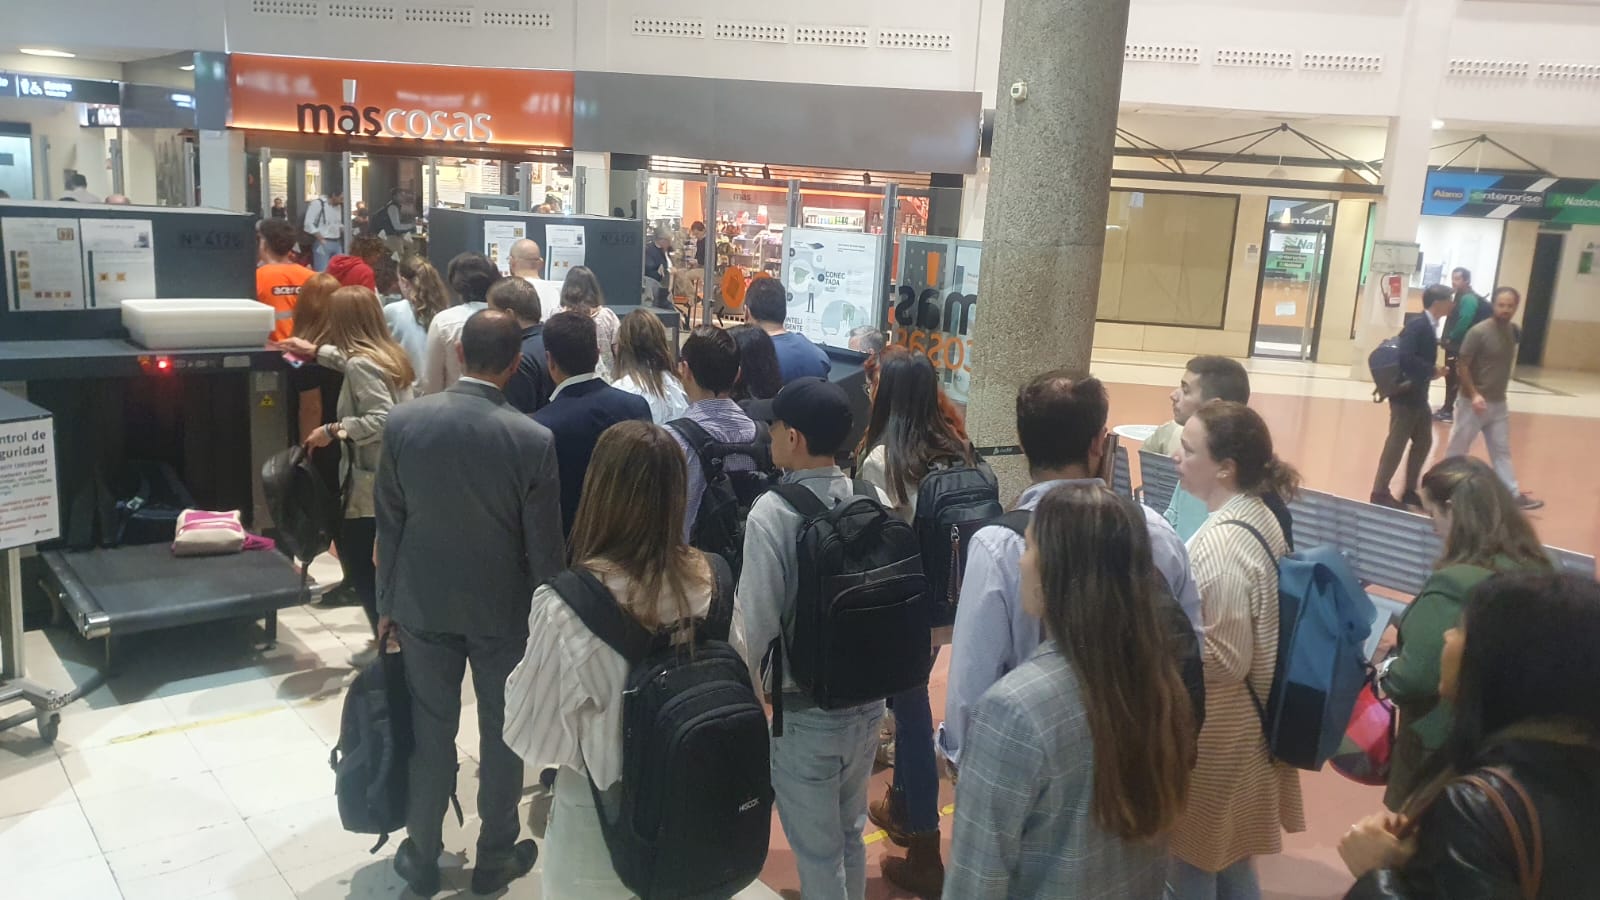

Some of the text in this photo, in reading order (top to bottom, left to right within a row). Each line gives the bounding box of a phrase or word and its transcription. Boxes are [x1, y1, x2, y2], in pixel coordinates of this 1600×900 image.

[1433, 189, 1464, 199] Alamo
[1471, 191, 1542, 203] enterprise
[1564, 196, 1600, 208] Nationa
[0, 430, 46, 444] ntrol de
[0, 443, 45, 461] guridad
